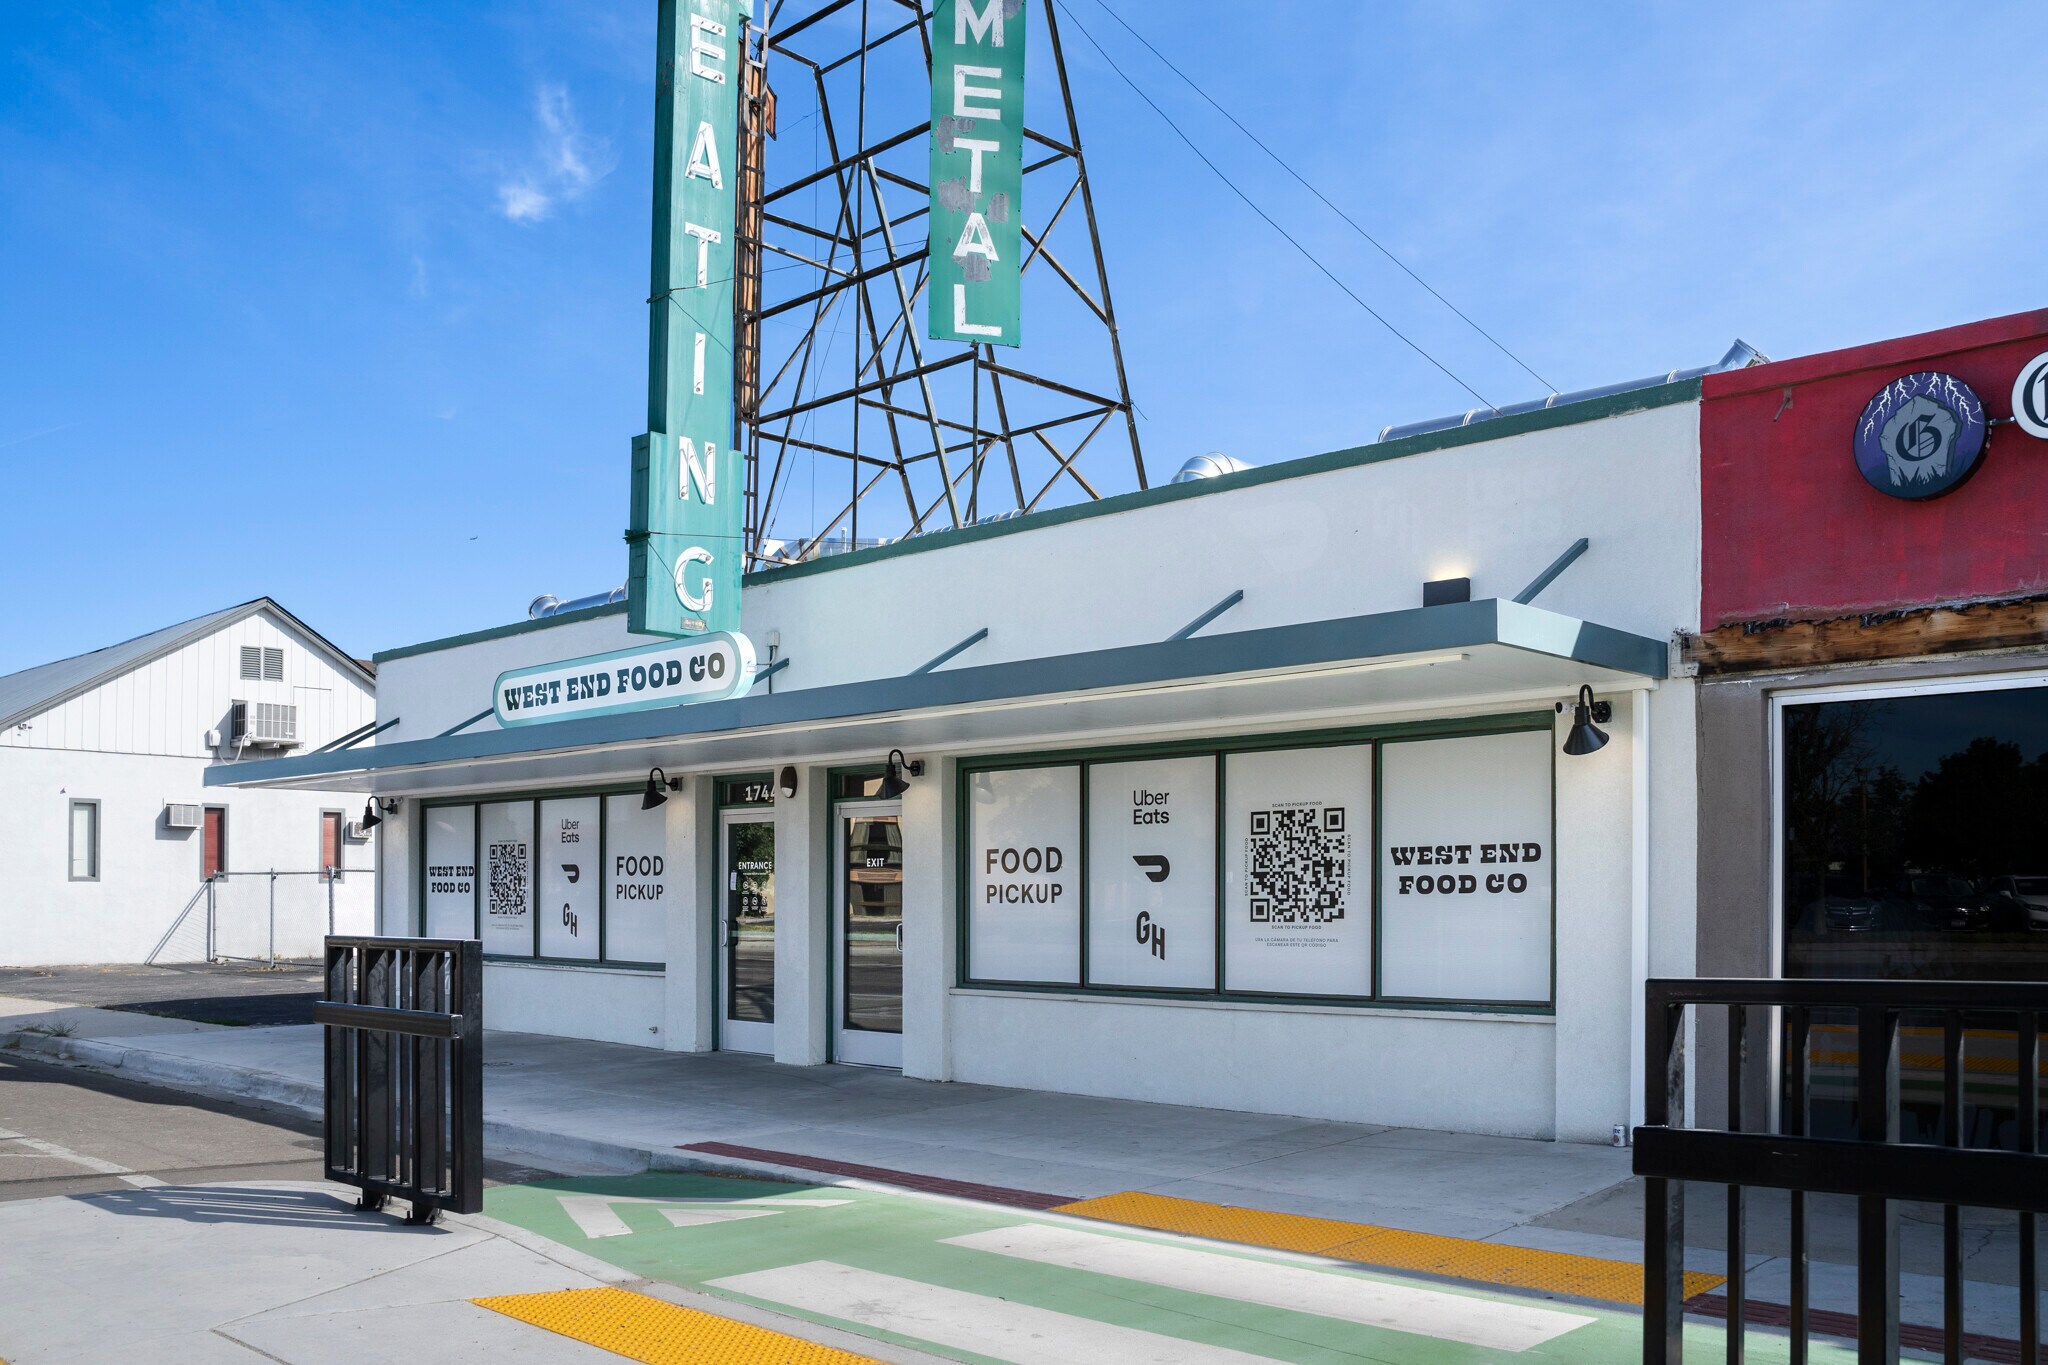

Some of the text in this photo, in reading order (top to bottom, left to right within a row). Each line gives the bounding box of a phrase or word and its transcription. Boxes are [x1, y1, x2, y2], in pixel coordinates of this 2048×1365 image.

[953, 0, 1004, 337] METAL
[674, 13, 726, 612] EATING
[504, 652, 726, 711] WEST END FOOD CO
[1133, 789, 1170, 806] Uber
[561, 818, 580, 830] Uber
[1133, 808, 1170, 825] Eats
[561, 831, 580, 844] Eats
[866, 857, 885, 868] EXIT
[986, 846, 1063, 874] FOOD
[1391, 842, 1542, 866] WEST END
[429, 866, 475, 877] WEST END
[616, 855, 664, 877] FOOD
[738, 861, 772, 870] ENTRANCE
[431, 882, 471, 893] FOOD CO
[616, 884, 664, 900] PICKUP
[986, 883, 1063, 904] PICKUP
[1399, 873, 1528, 895] FOOD CO
[563, 903, 578, 938] GH
[1136, 911, 1166, 961] GH
